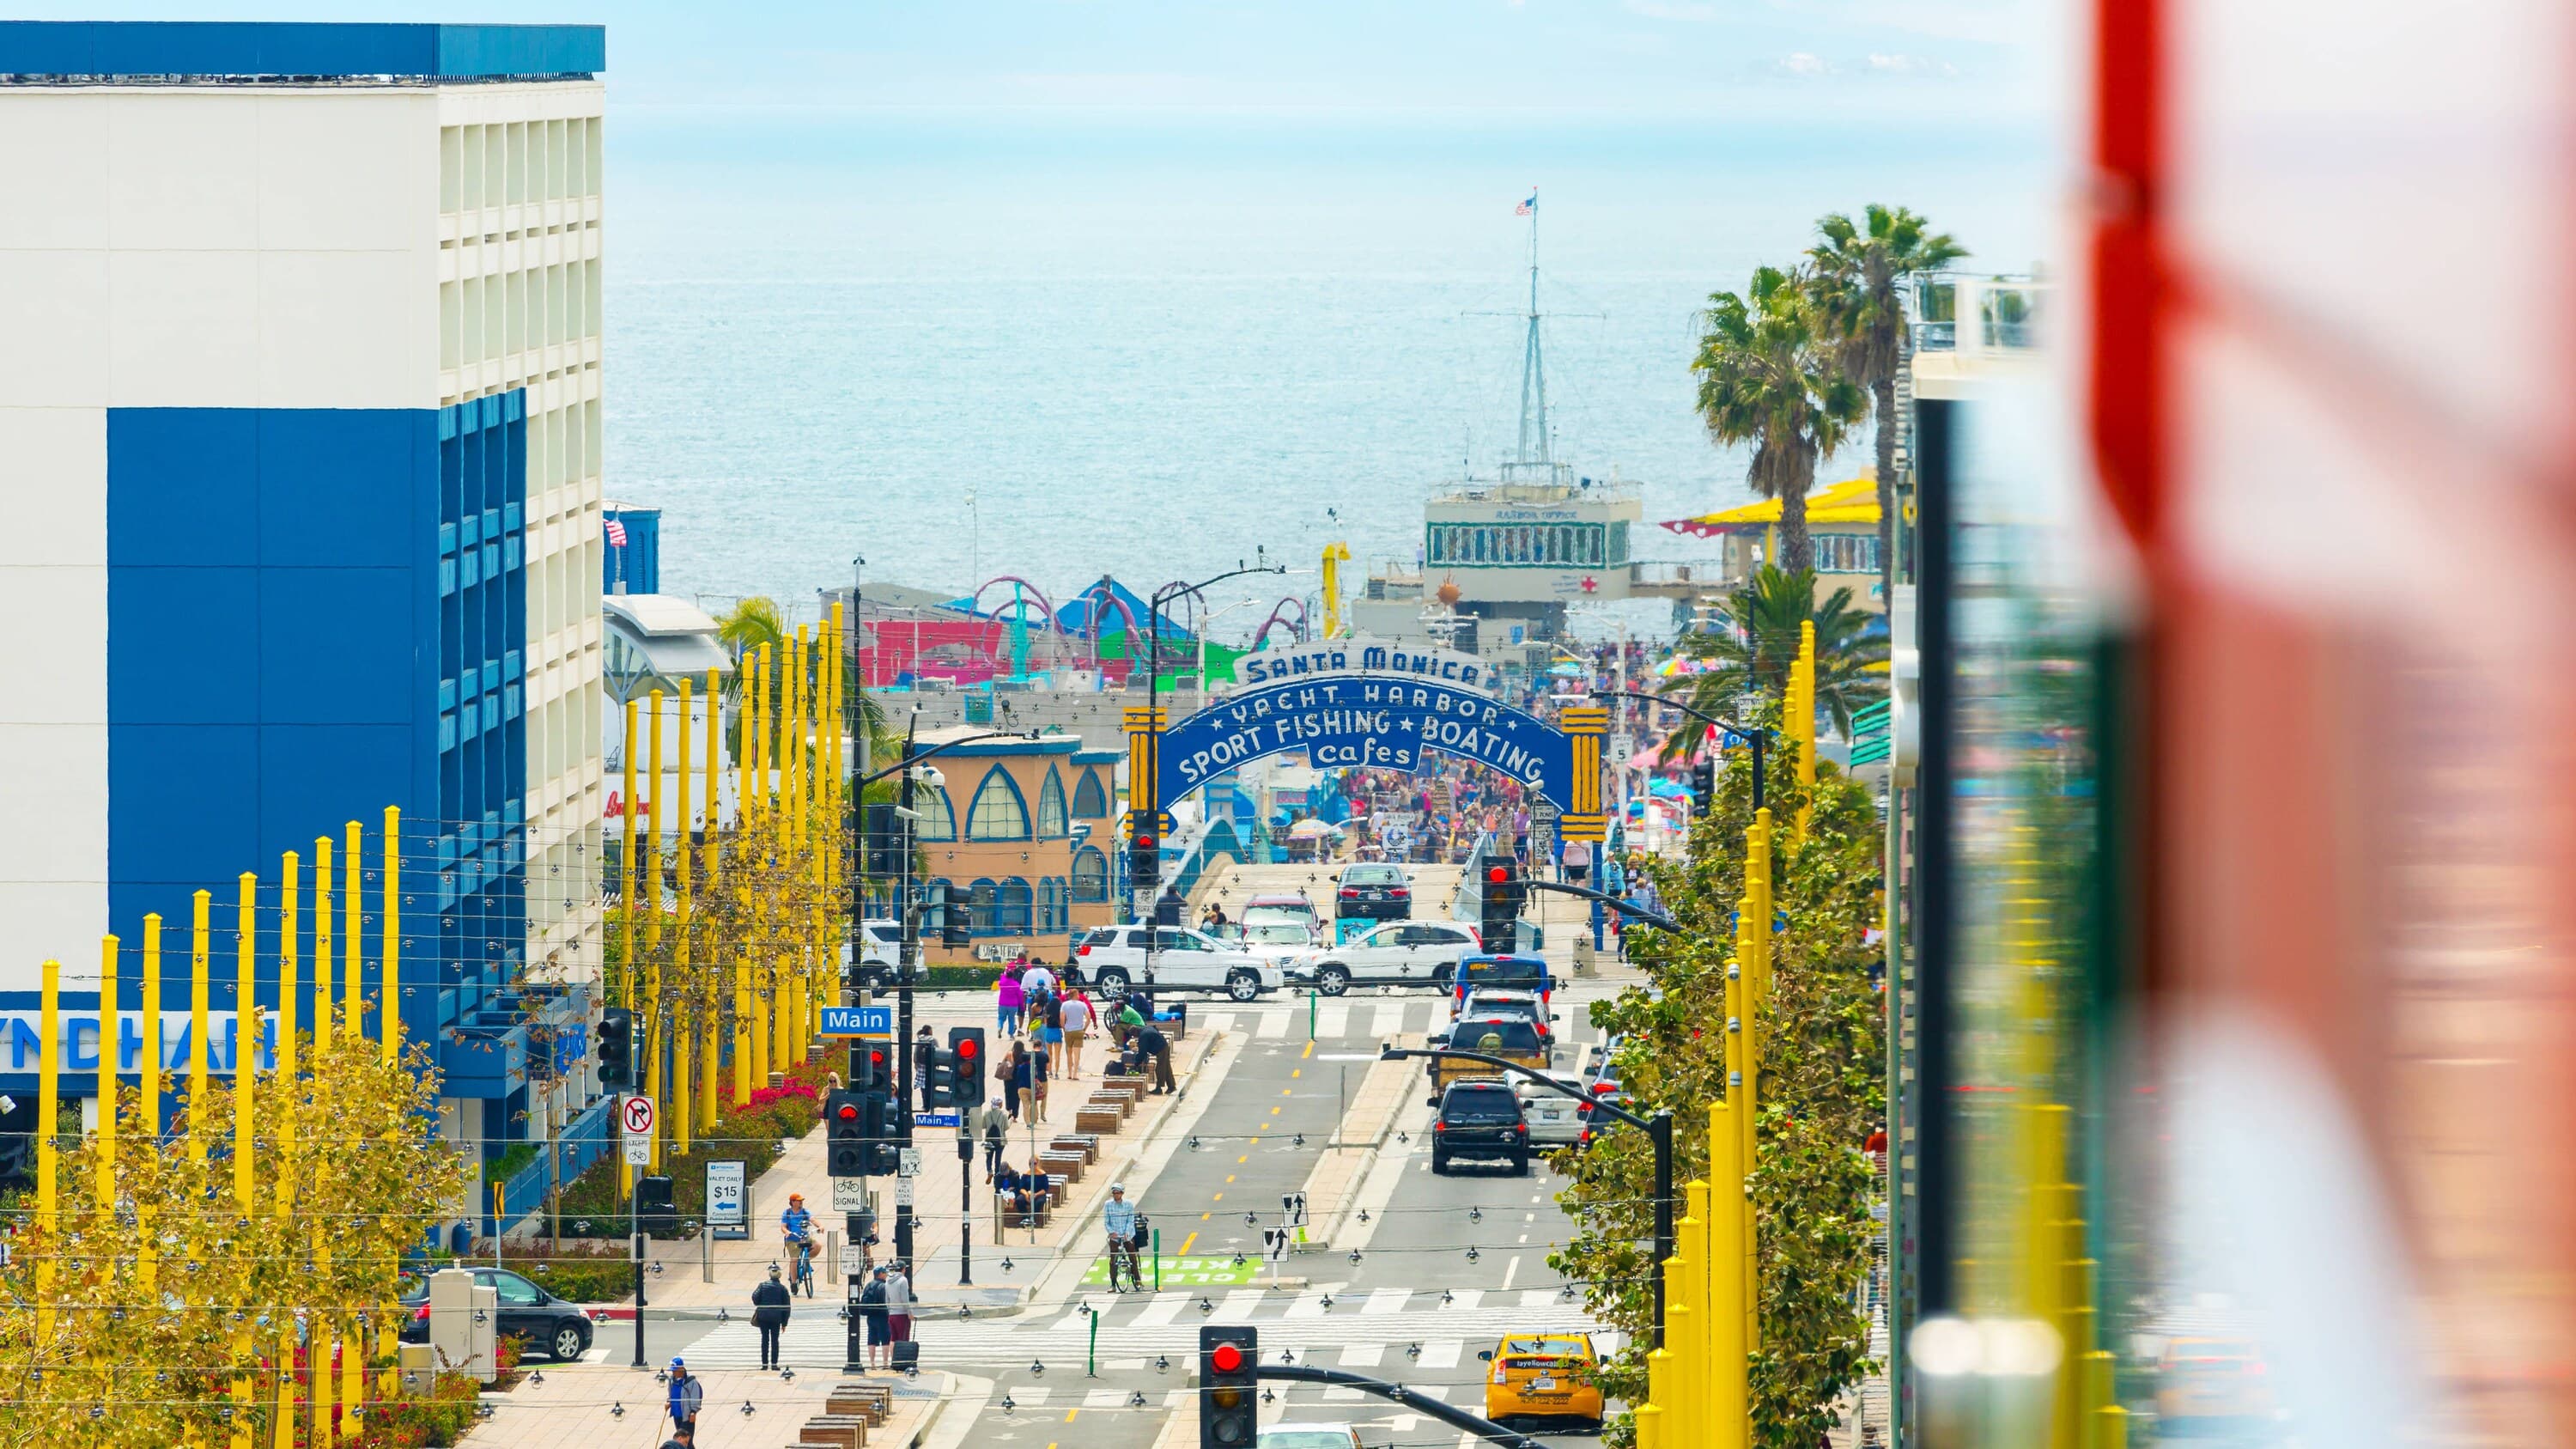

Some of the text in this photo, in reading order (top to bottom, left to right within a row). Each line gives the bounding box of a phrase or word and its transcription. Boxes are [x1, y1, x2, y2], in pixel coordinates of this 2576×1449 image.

[1246, 647, 1479, 685] SANTA MONICA
[1231, 685, 1498, 726] YACHT HARBOR
[1179, 710, 1545, 783] SPORT FISHING BOATING
[1317, 738, 1410, 765] cafes
[1618, 749, 1625, 759] 5
[829, 1010, 883, 1028] Main
[917, 1116, 942, 1124] Main
[902, 1163, 909, 1173] OK
[714, 1186, 737, 1198] $15
